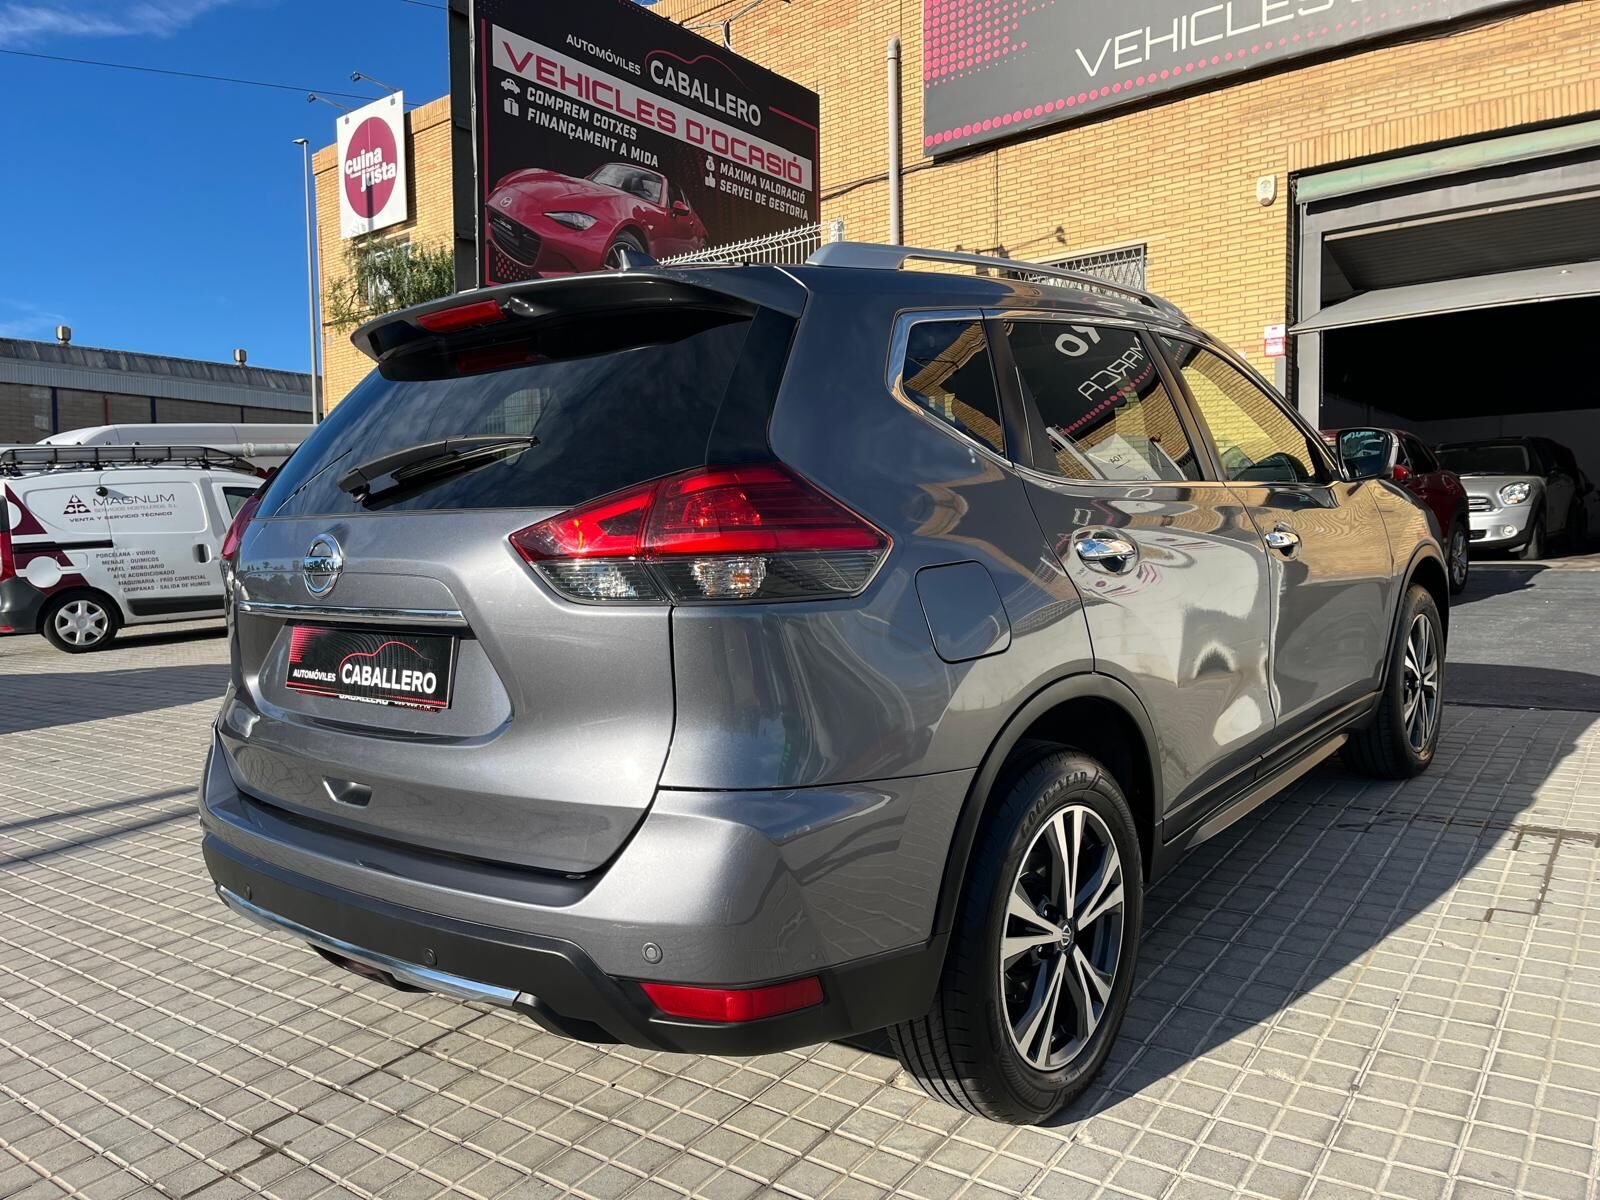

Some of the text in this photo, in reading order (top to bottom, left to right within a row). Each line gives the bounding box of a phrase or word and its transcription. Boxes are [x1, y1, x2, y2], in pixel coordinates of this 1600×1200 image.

[566, 34, 641, 75] AUTOMÓVILES
[502, 40, 802, 184] VEHICLES D'OCASIÓ
[526, 86, 637, 140] COMPREM COTXES
[650, 60, 761, 126] CABALLERO
[527, 107, 658, 168] FINANÇAMENT A MIDA
[345, 147, 382, 175] cuina
[360, 162, 396, 192] justa
[719, 162, 805, 204] MÀXIMA VALORACIÓ
[720, 179, 808, 221] SERVEI DE GESTORIA
[92, 493, 176, 506] MAGNUM
[175, 574, 206, 582] COMERCIAL
[292, 663, 437, 694] AUTOMÓVILES CABALLERO
